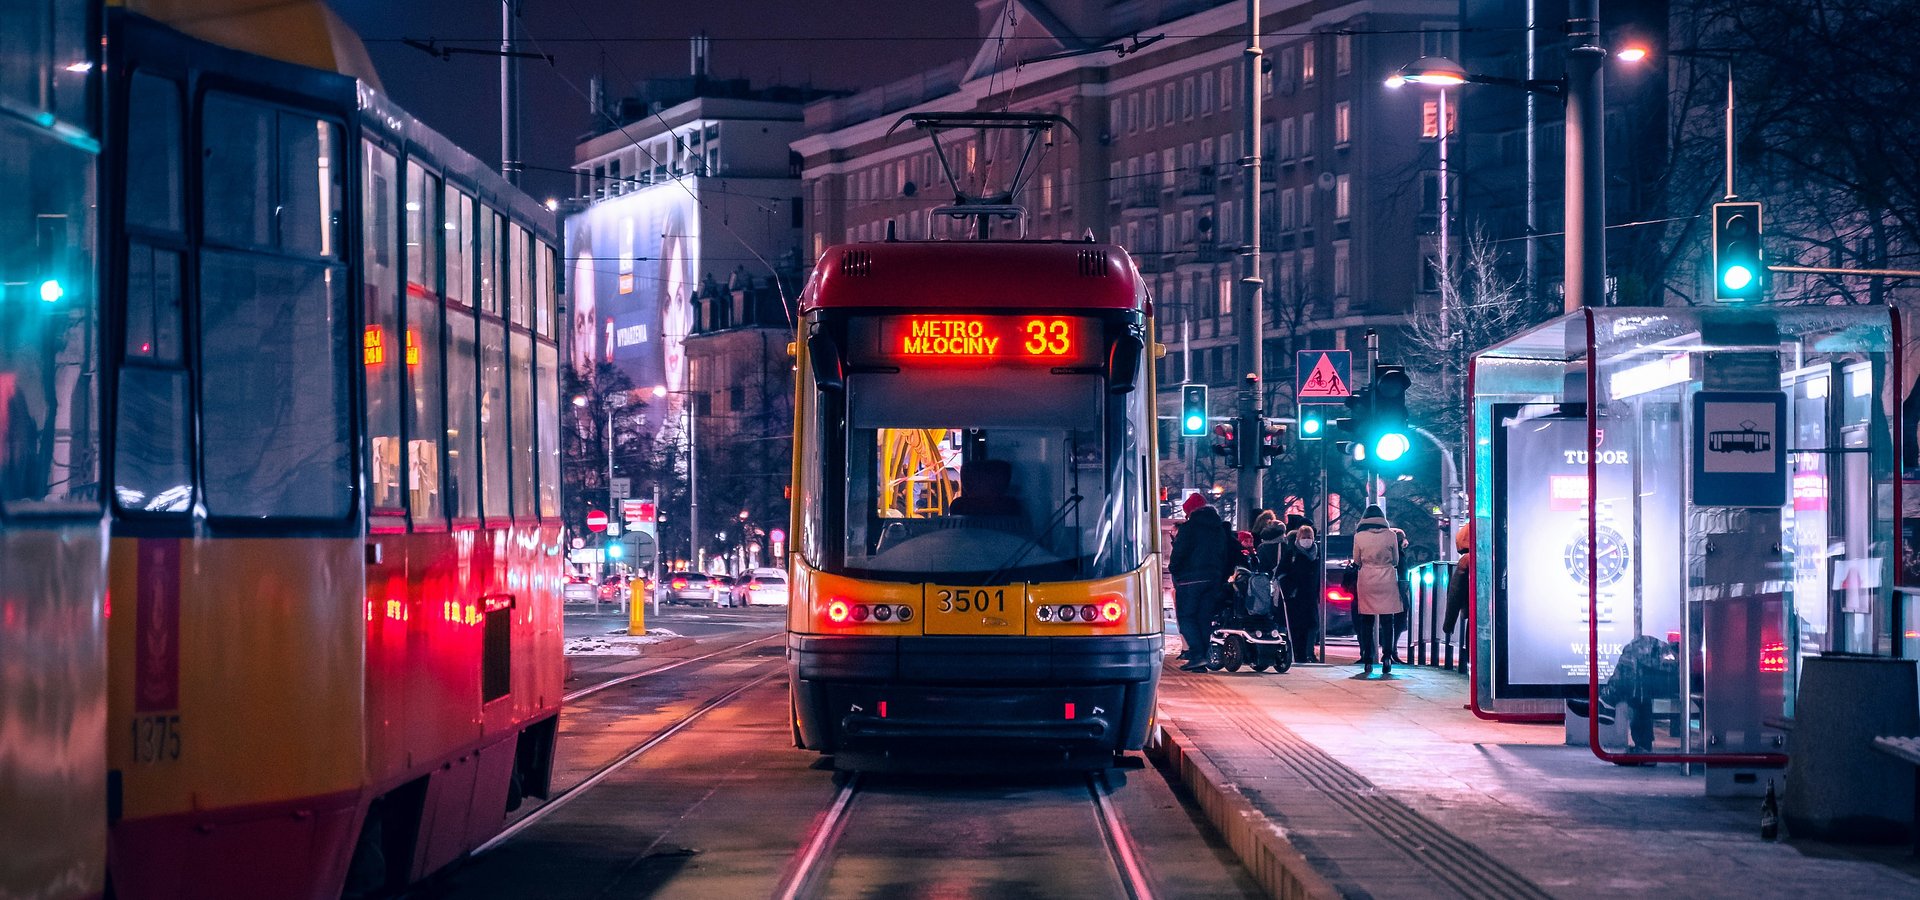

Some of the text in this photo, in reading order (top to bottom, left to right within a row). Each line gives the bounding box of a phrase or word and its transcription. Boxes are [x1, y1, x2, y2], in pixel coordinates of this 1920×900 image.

[912, 320, 984, 338] METRO
[1025, 320, 1070, 355] 33
[904, 336, 999, 354] MŁOCINY
[1564, 449, 1629, 465] TUDOR
[937, 589, 1004, 613] 3501
[131, 716, 181, 763] 1375
